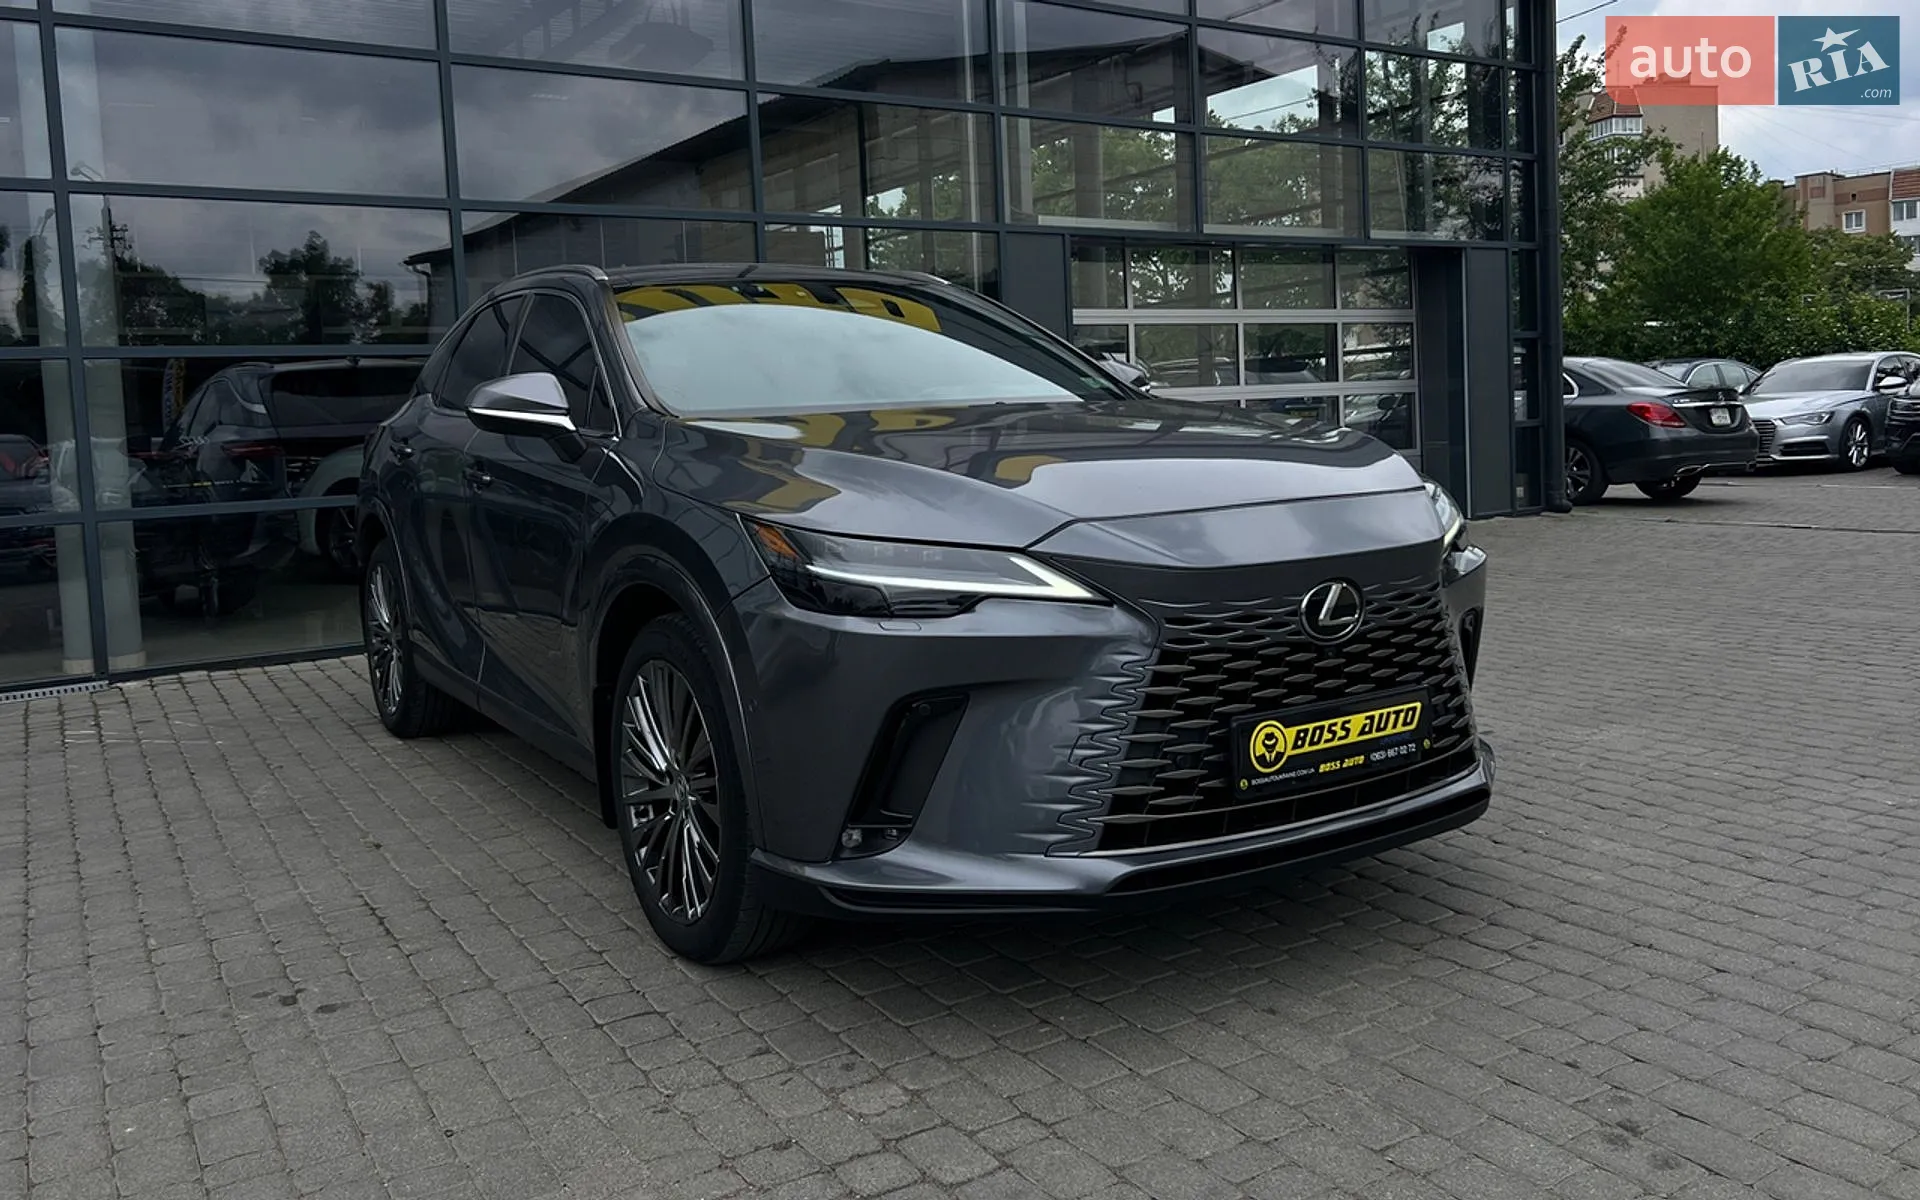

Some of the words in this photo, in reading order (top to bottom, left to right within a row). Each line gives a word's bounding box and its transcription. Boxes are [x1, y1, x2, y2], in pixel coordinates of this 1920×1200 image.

[1291, 719, 1352, 750] BOSS
[1357, 705, 1418, 737] AUTO
[1319, 760, 1341, 772] BOSS
[1342, 755, 1365, 768] AUTO
